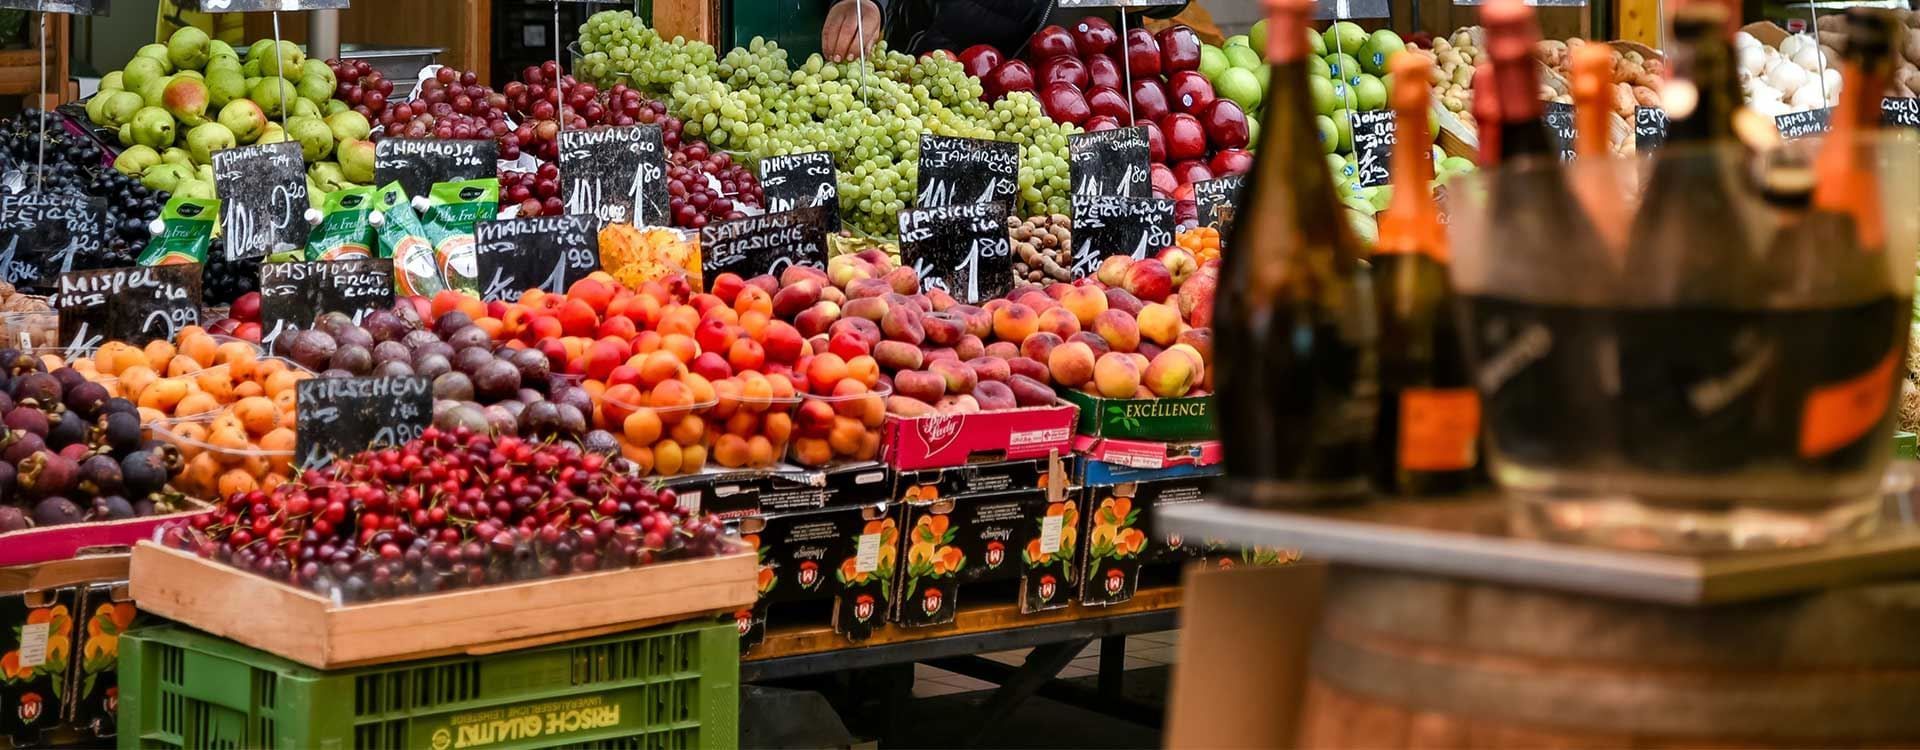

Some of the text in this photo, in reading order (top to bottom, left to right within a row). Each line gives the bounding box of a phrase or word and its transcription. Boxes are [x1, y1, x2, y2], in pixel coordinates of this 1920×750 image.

[562, 127, 641, 149] KIWANO
[701, 216, 787, 246] SATURN
[1127, 402, 1207, 418] EXCELLENCE
[545, 704, 620, 735] FRISCHE
